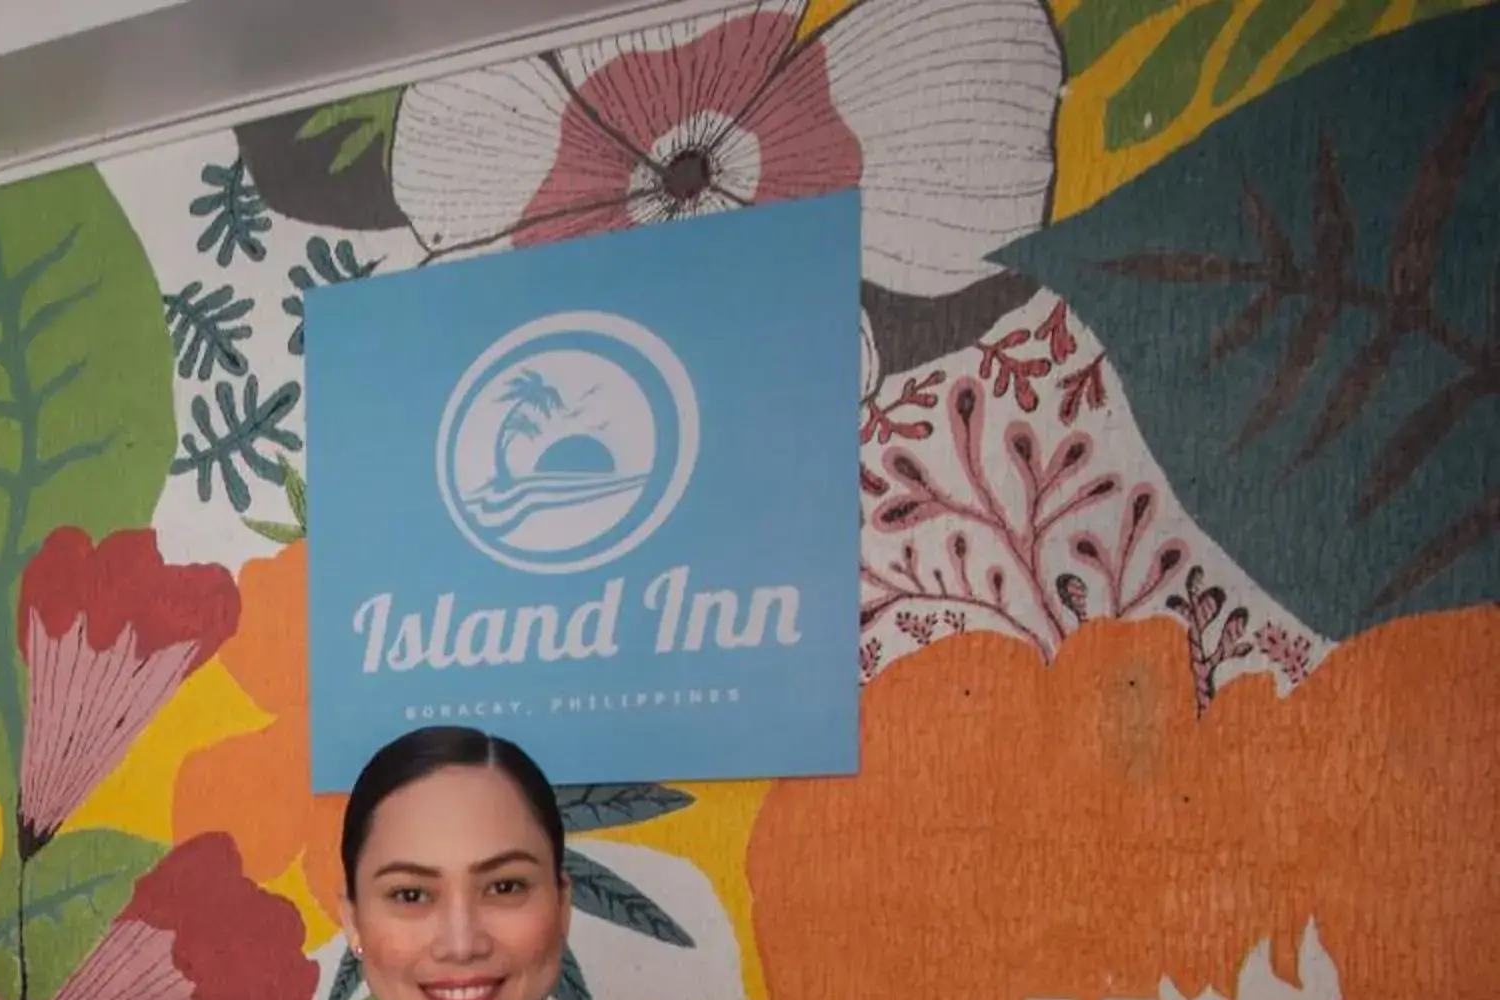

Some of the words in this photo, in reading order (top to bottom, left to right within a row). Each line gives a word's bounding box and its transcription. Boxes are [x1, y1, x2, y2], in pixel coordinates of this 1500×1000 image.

[353, 578, 624, 673] Island
[643, 566, 801, 654] Inn
[551, 688, 740, 713] PHILIPPINES
